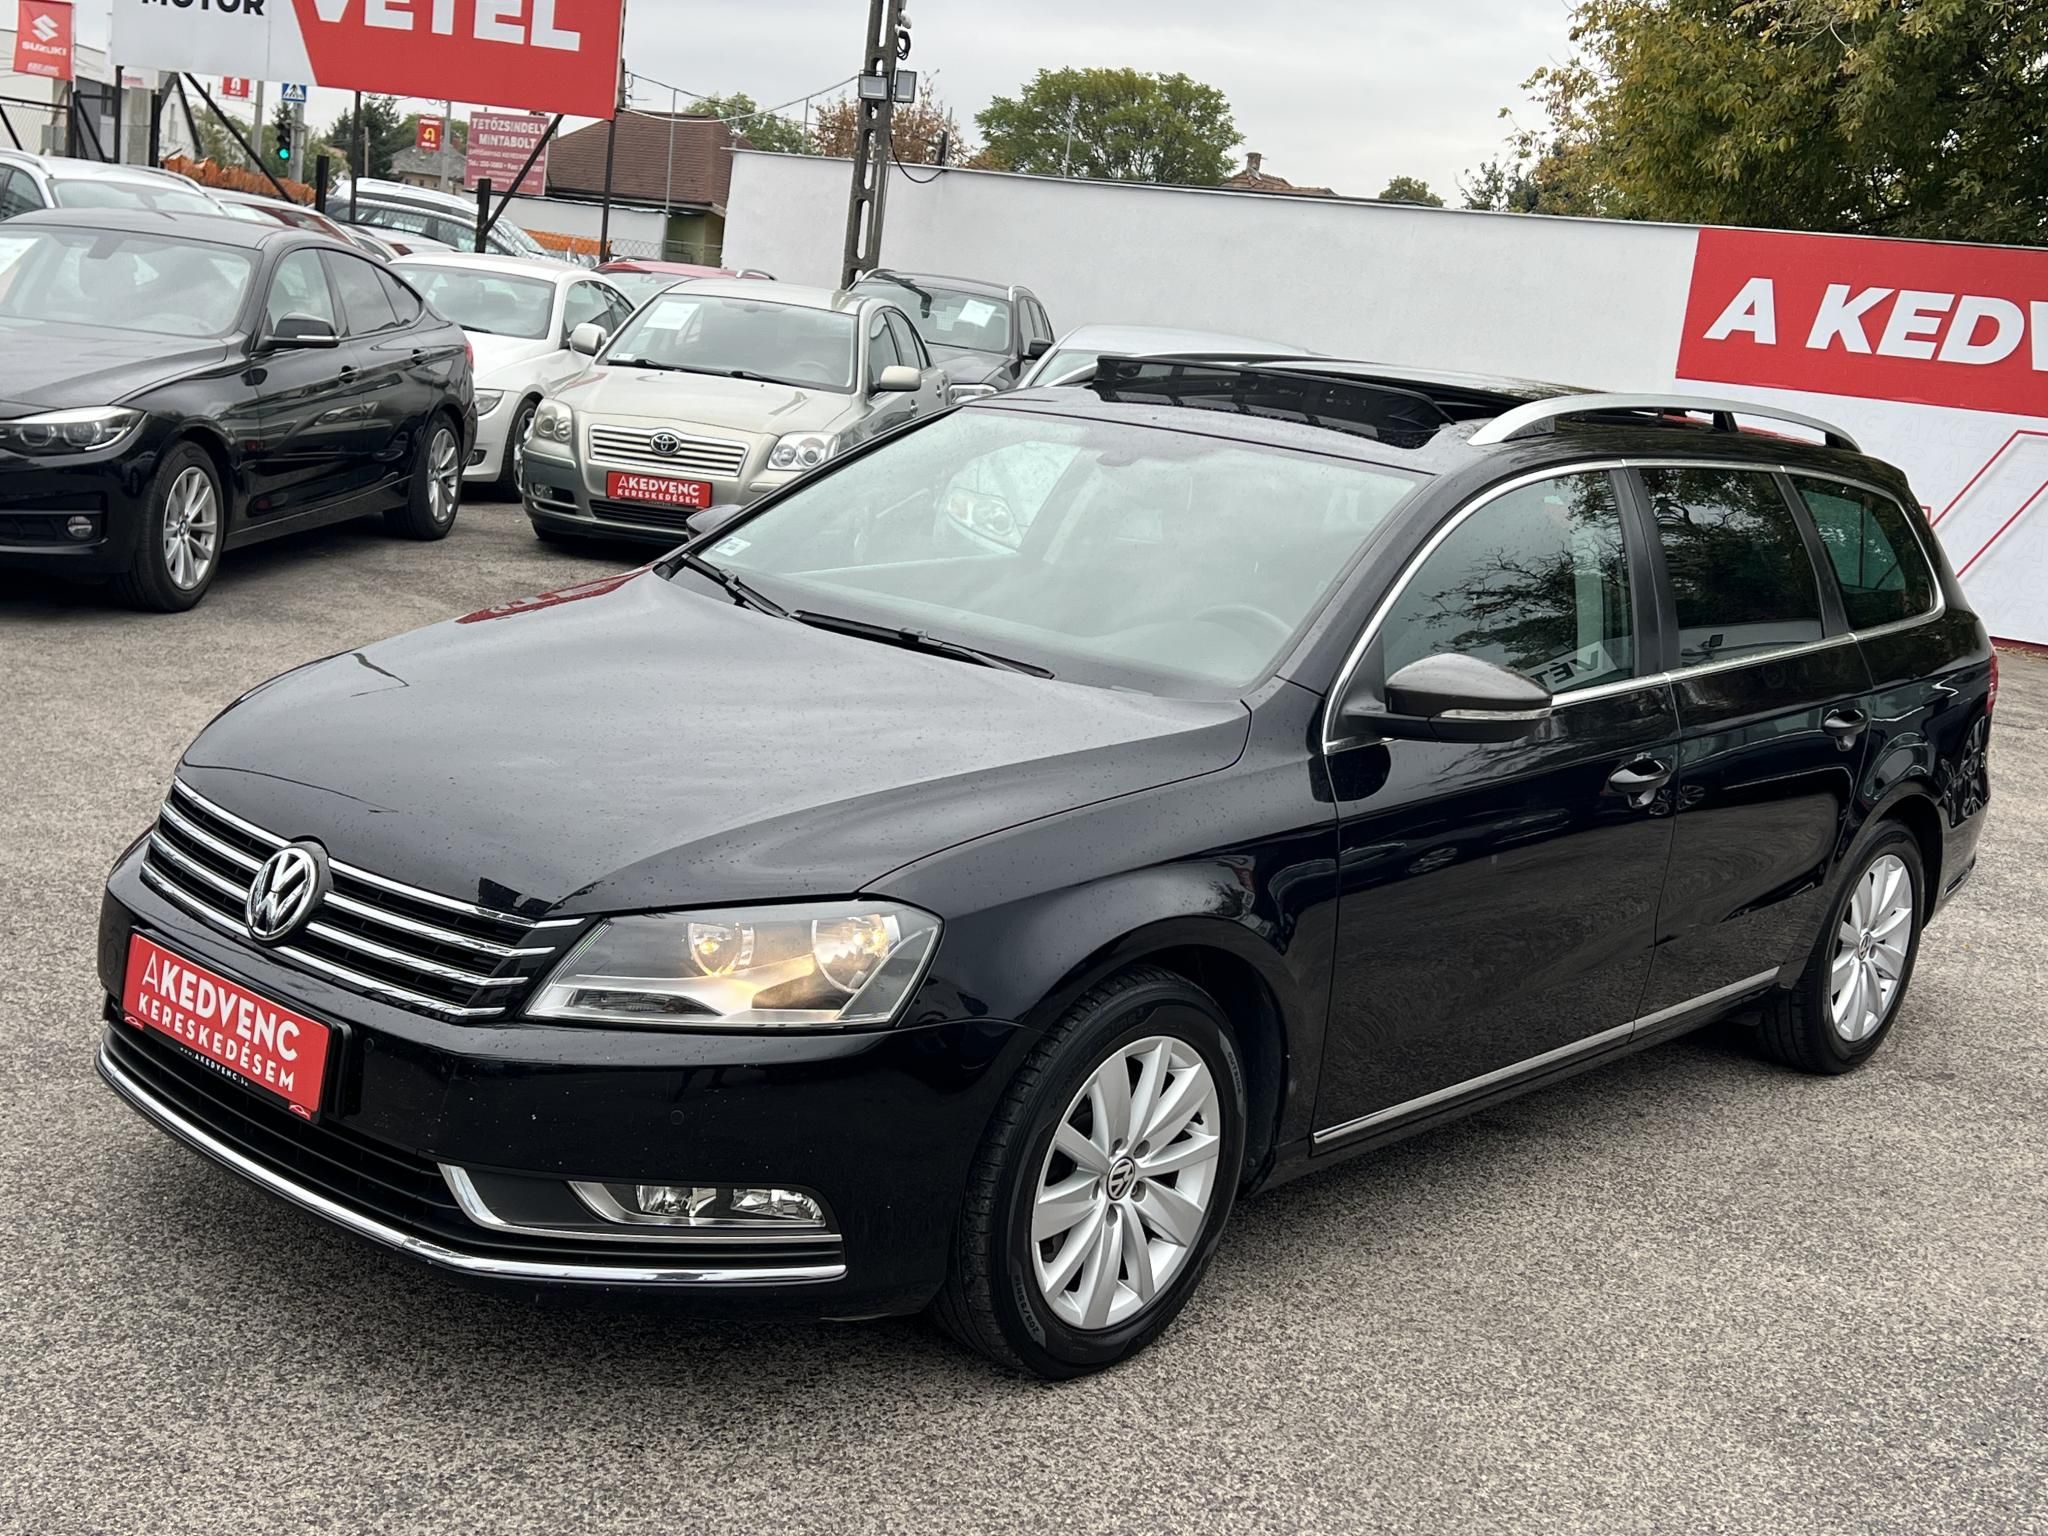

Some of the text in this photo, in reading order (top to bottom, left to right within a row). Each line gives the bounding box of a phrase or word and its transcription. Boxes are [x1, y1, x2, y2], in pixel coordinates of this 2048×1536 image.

[21, 41, 67, 56] SUZUKI
[478, 133, 537, 149] MINTABOLT
[1703, 277, 1777, 345] A
[617, 488, 700, 505] KERESKEDÉSEM
[142, 950, 300, 1062] AKEDVENC
[138, 991, 295, 1092] KERESKEDÉSEM
